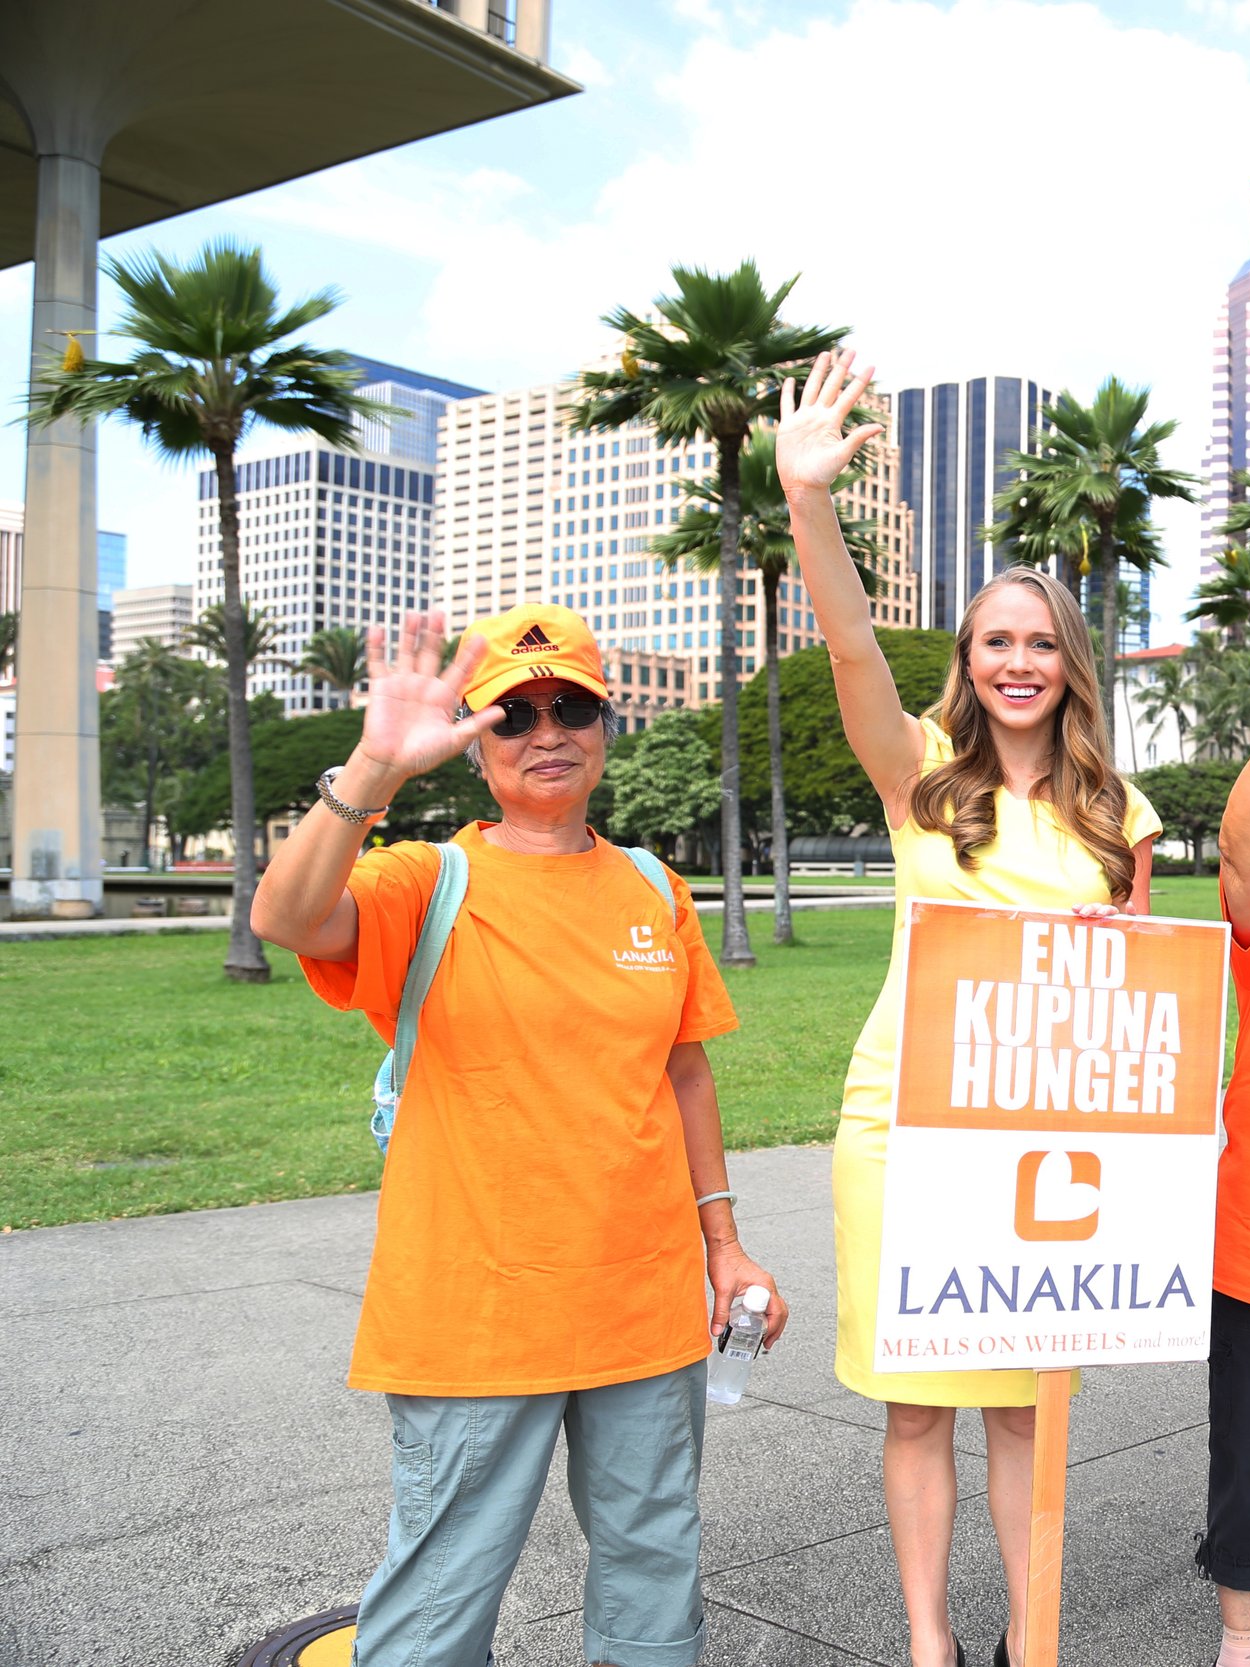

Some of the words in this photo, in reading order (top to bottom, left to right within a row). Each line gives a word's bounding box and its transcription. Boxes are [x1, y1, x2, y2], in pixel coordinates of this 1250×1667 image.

[511, 645, 559, 655] adidas
[612, 949, 674, 963] LANAKILA
[1021, 921, 1126, 989] END
[953, 979, 1181, 1054] KUPUNA
[950, 1043, 1176, 1115] HUNGER
[898, 1263, 1196, 1315] LANAKILA
[882, 1336, 970, 1358] MEALS
[978, 1335, 1016, 1355] ON
[1026, 1331, 1127, 1353] WHEELS
[1133, 1330, 1162, 1350] and
[1167, 1330, 1206, 1349] more!
